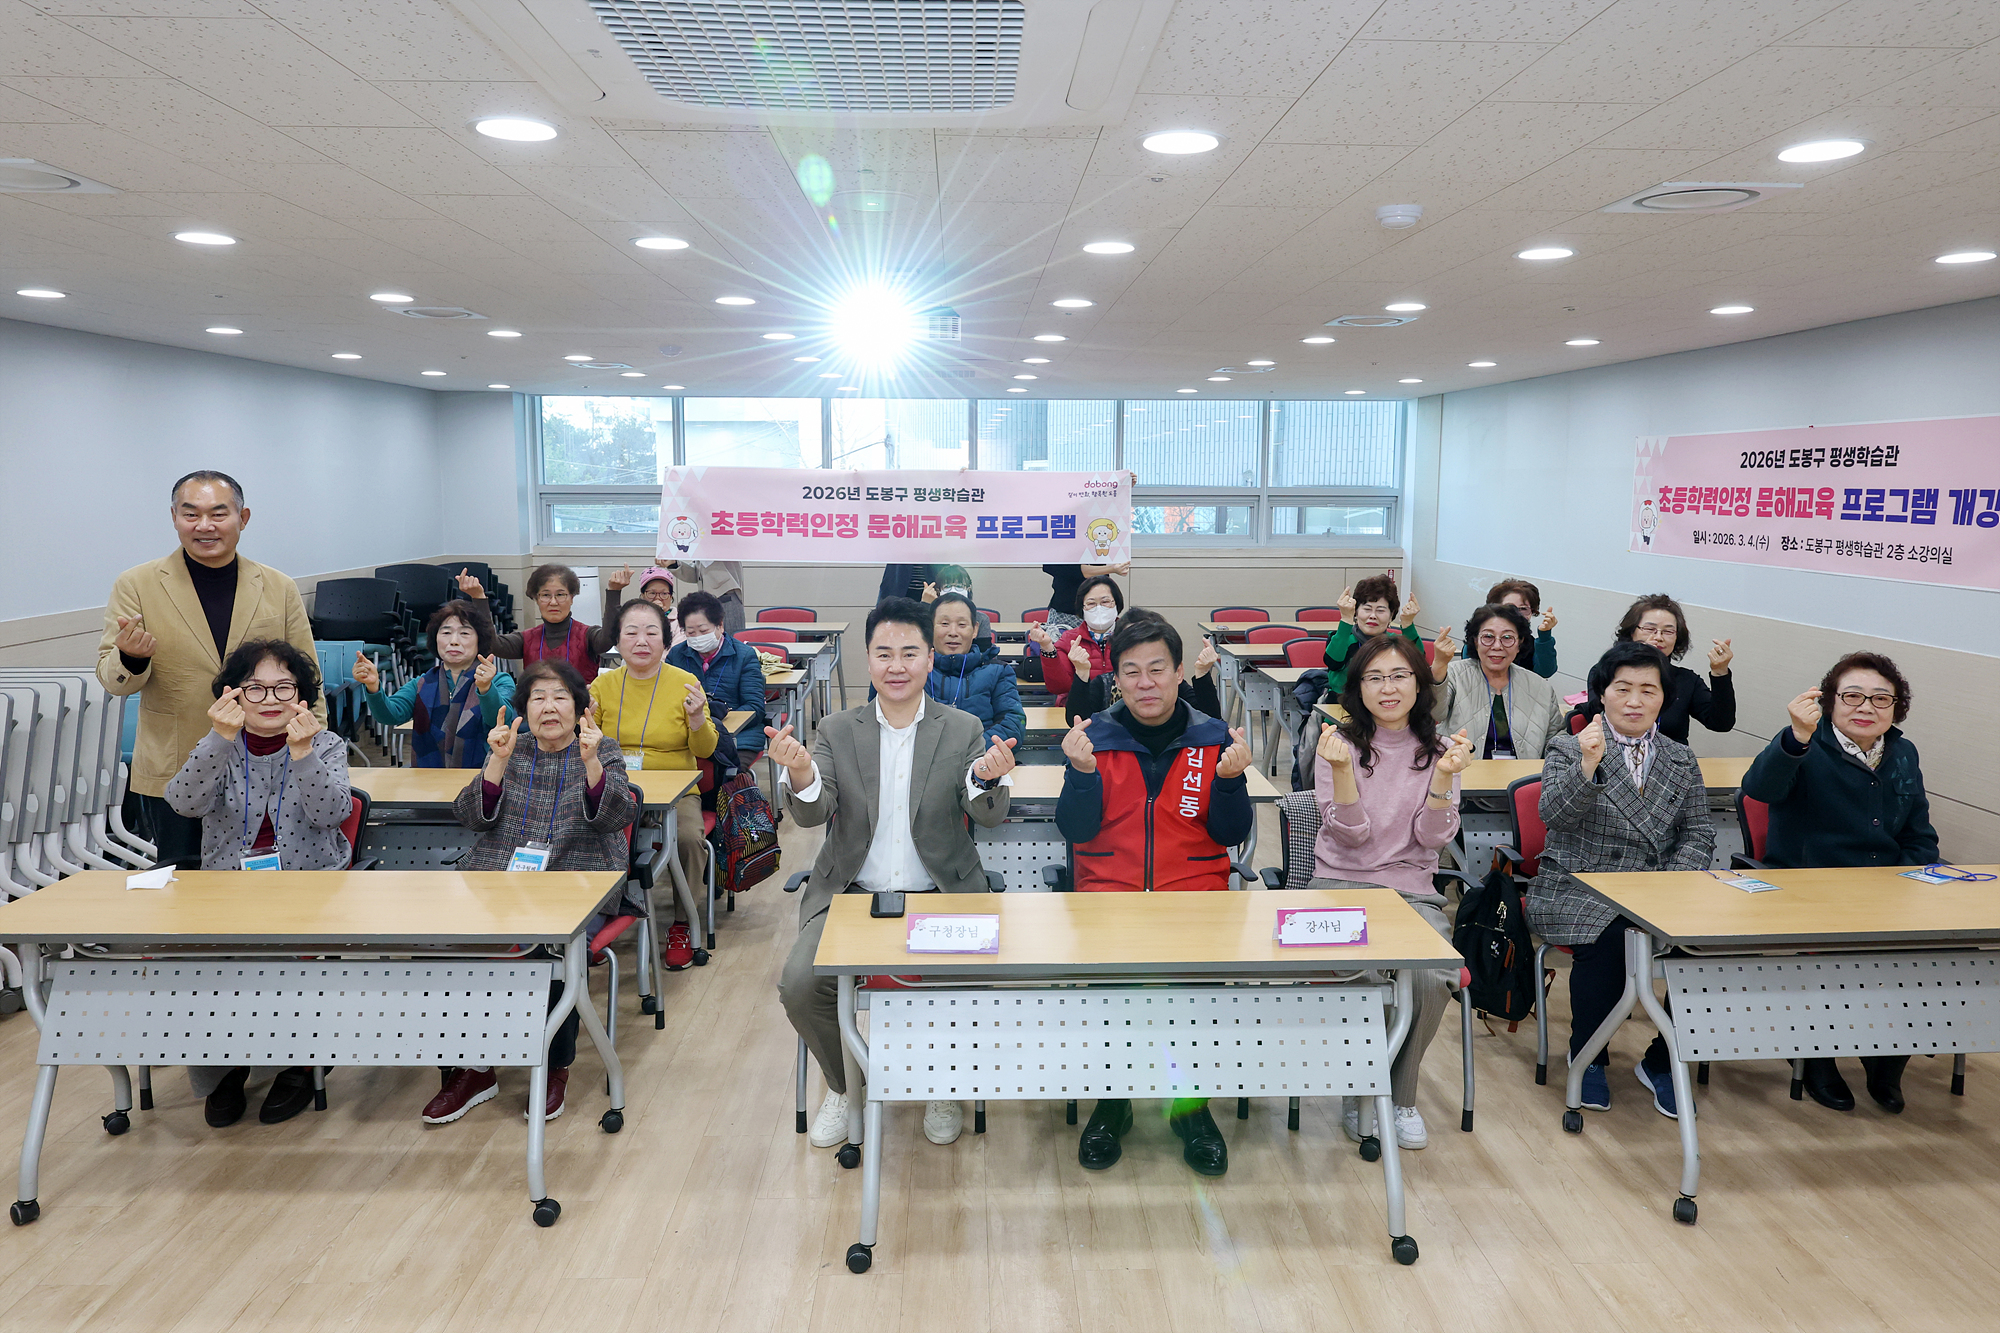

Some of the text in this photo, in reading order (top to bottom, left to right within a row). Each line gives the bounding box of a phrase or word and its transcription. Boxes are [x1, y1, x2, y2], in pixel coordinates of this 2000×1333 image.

[1740, 445, 1900, 468] 2026년 도봉구 평생학습관
[802, 486, 986, 503] 2026년 도봉구 평생학습관
[1084, 480, 1118, 489] dobong
[1658, 485, 1752, 517] 초등학력인정
[1756, 486, 1835, 520] 문해교육
[1840, 488, 1940, 525] 프로그램
[711, 510, 1076, 539] 초등학력인정 문해교육 프로그램
[1805, 538, 1833, 554] 도봉구
[1835, 539, 1884, 559] 평생학습관
[1887, 543, 1905, 561] 2층
[1907, 545, 1953, 565] 소강의실
[1179, 747, 1204, 818] 김선동
[929, 924, 978, 938] 구청장님
[1306, 919, 1341, 933] 강사님
